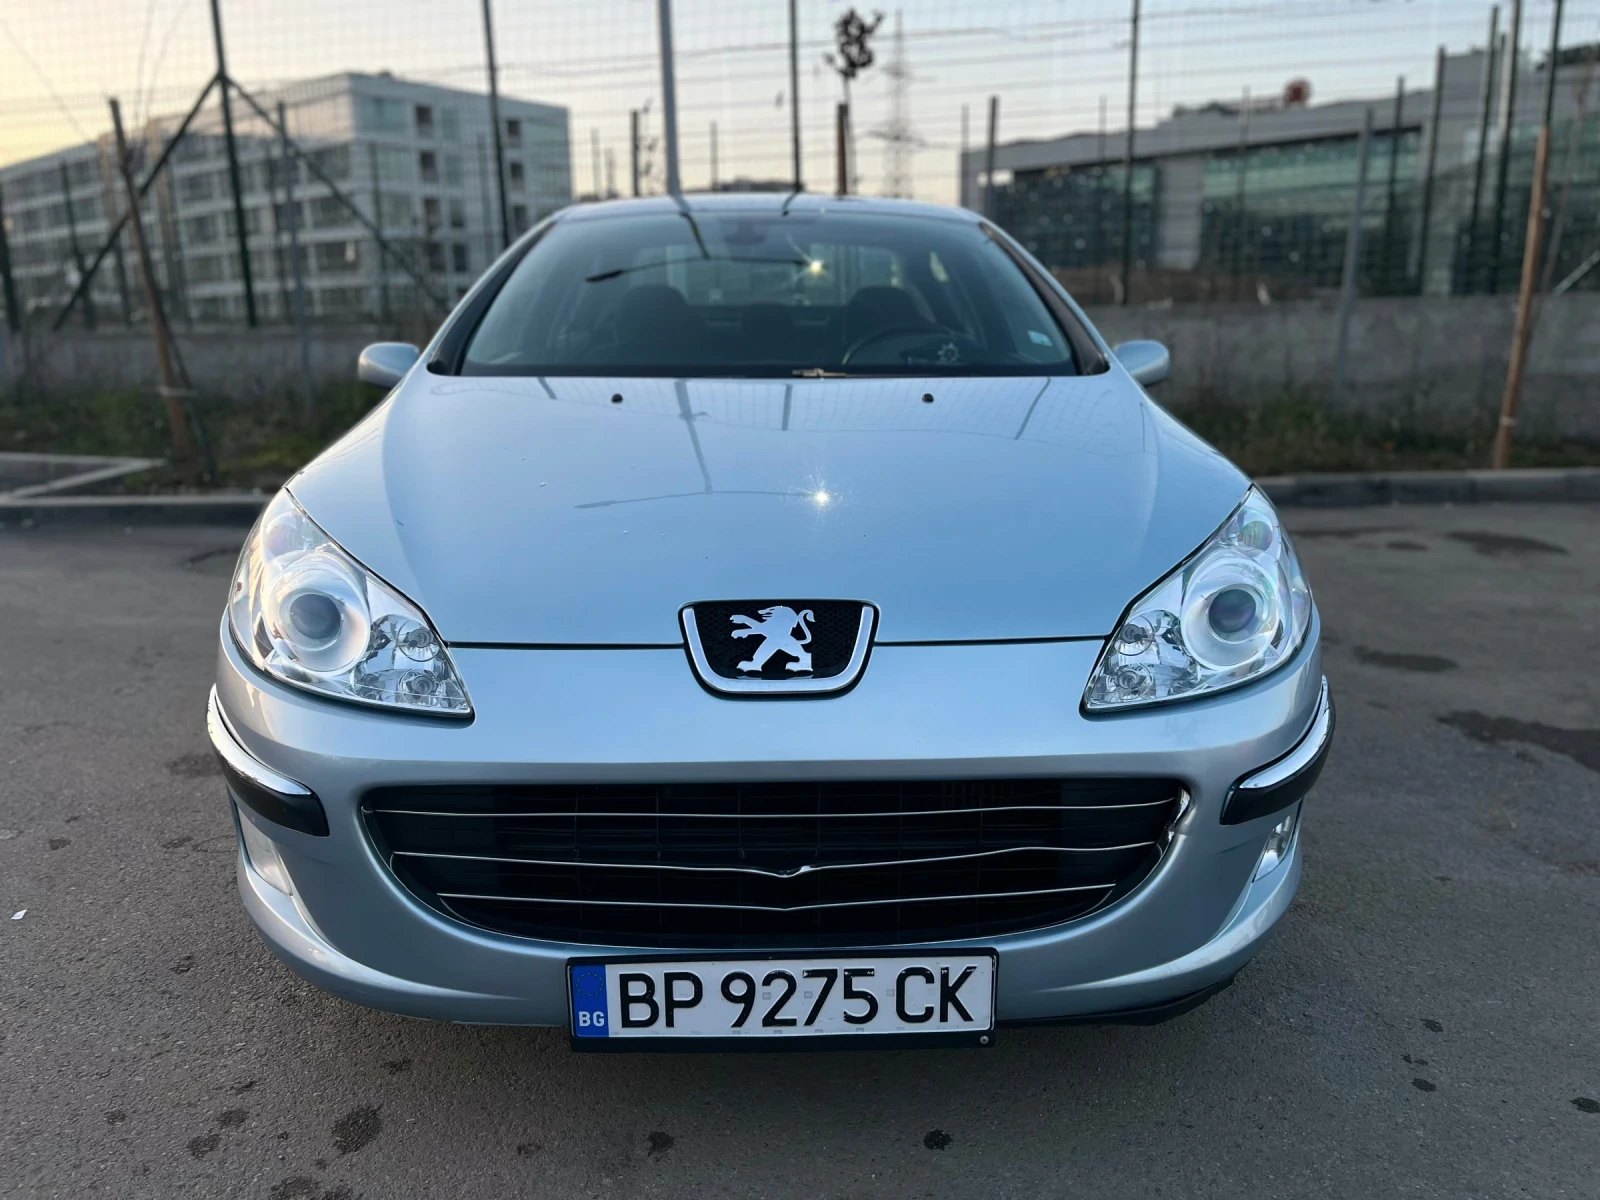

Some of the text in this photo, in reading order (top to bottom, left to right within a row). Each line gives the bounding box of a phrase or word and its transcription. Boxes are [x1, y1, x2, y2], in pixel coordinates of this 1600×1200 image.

[619, 966, 977, 1028] BP 9275 CK
[578, 1010, 605, 1027] BG
